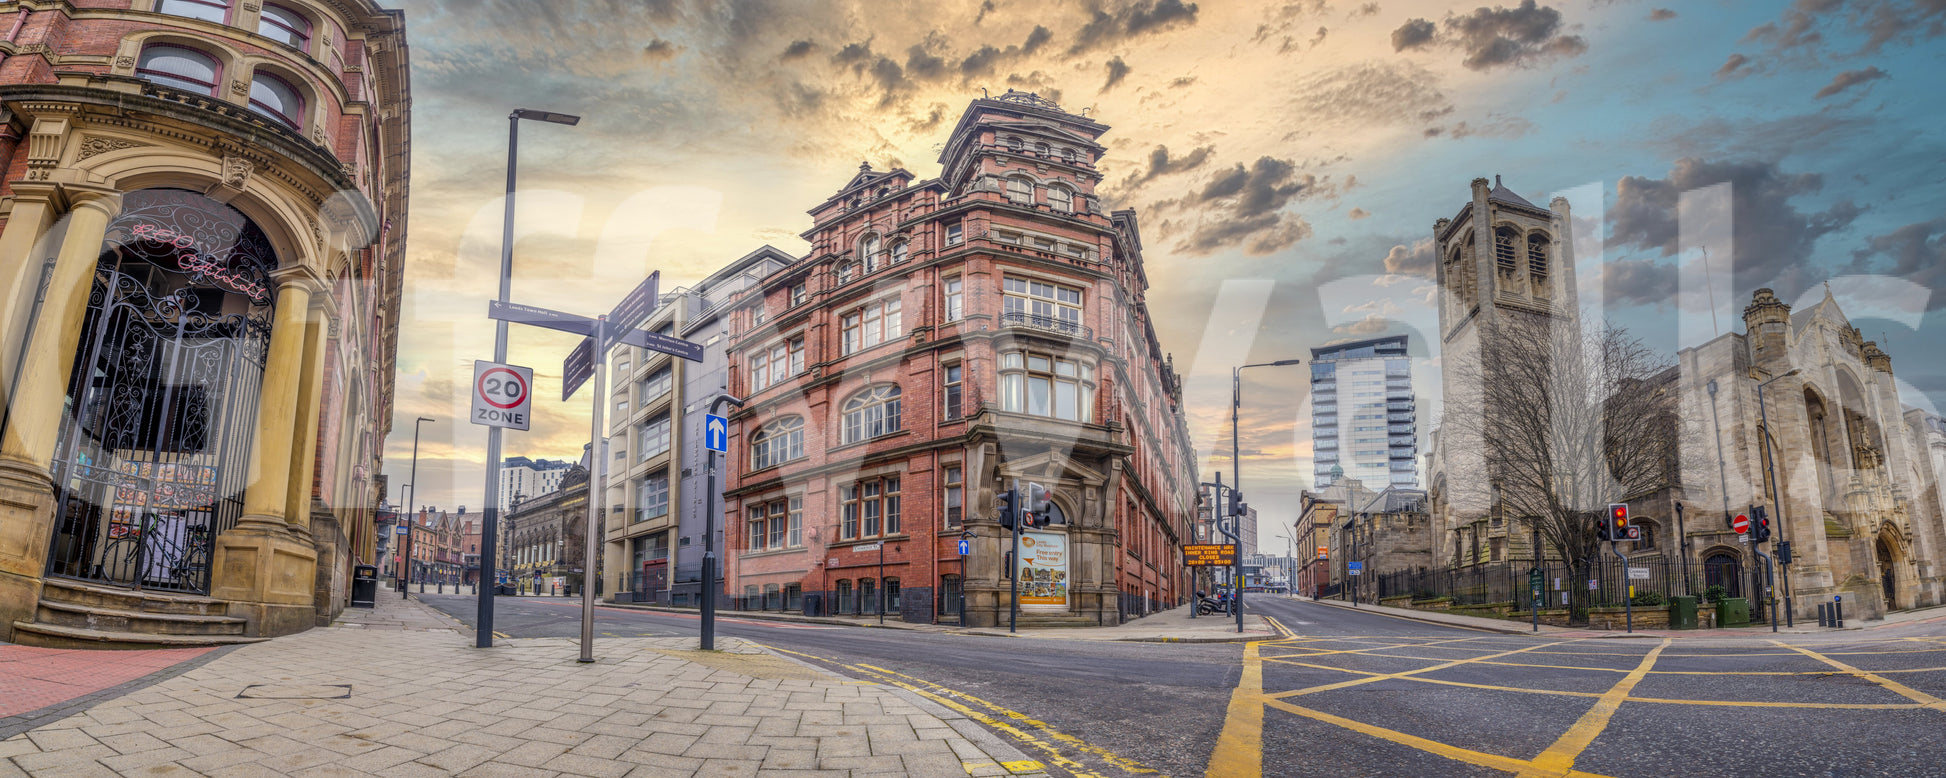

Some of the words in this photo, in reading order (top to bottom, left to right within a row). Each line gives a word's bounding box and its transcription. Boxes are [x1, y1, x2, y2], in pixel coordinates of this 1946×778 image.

[133, 224, 194, 249] RED
[486, 378, 520, 398] 20
[478, 408, 523, 425] ZONE
